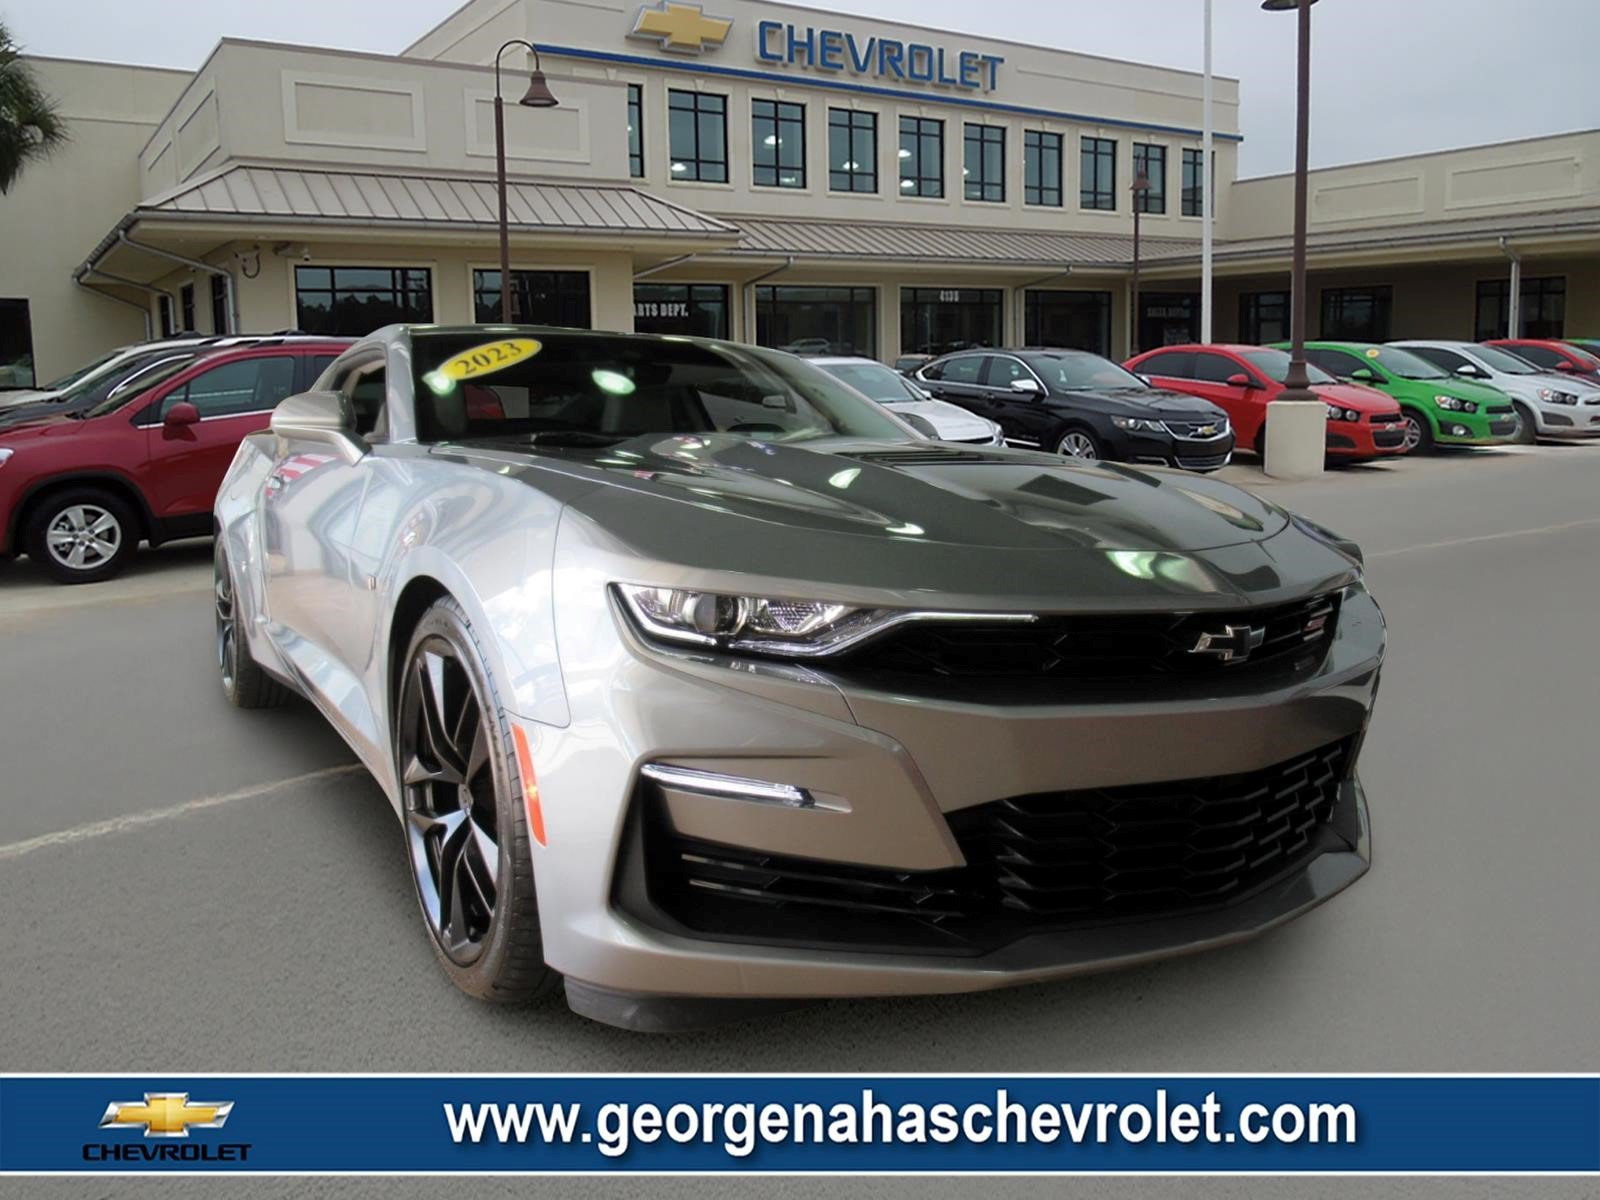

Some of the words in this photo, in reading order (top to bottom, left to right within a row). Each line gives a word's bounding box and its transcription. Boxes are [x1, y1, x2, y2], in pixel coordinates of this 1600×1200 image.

[758, 20, 1005, 91] CHEVROLET
[660, 303, 689, 317] DEPT.
[455, 342, 522, 375] 2023
